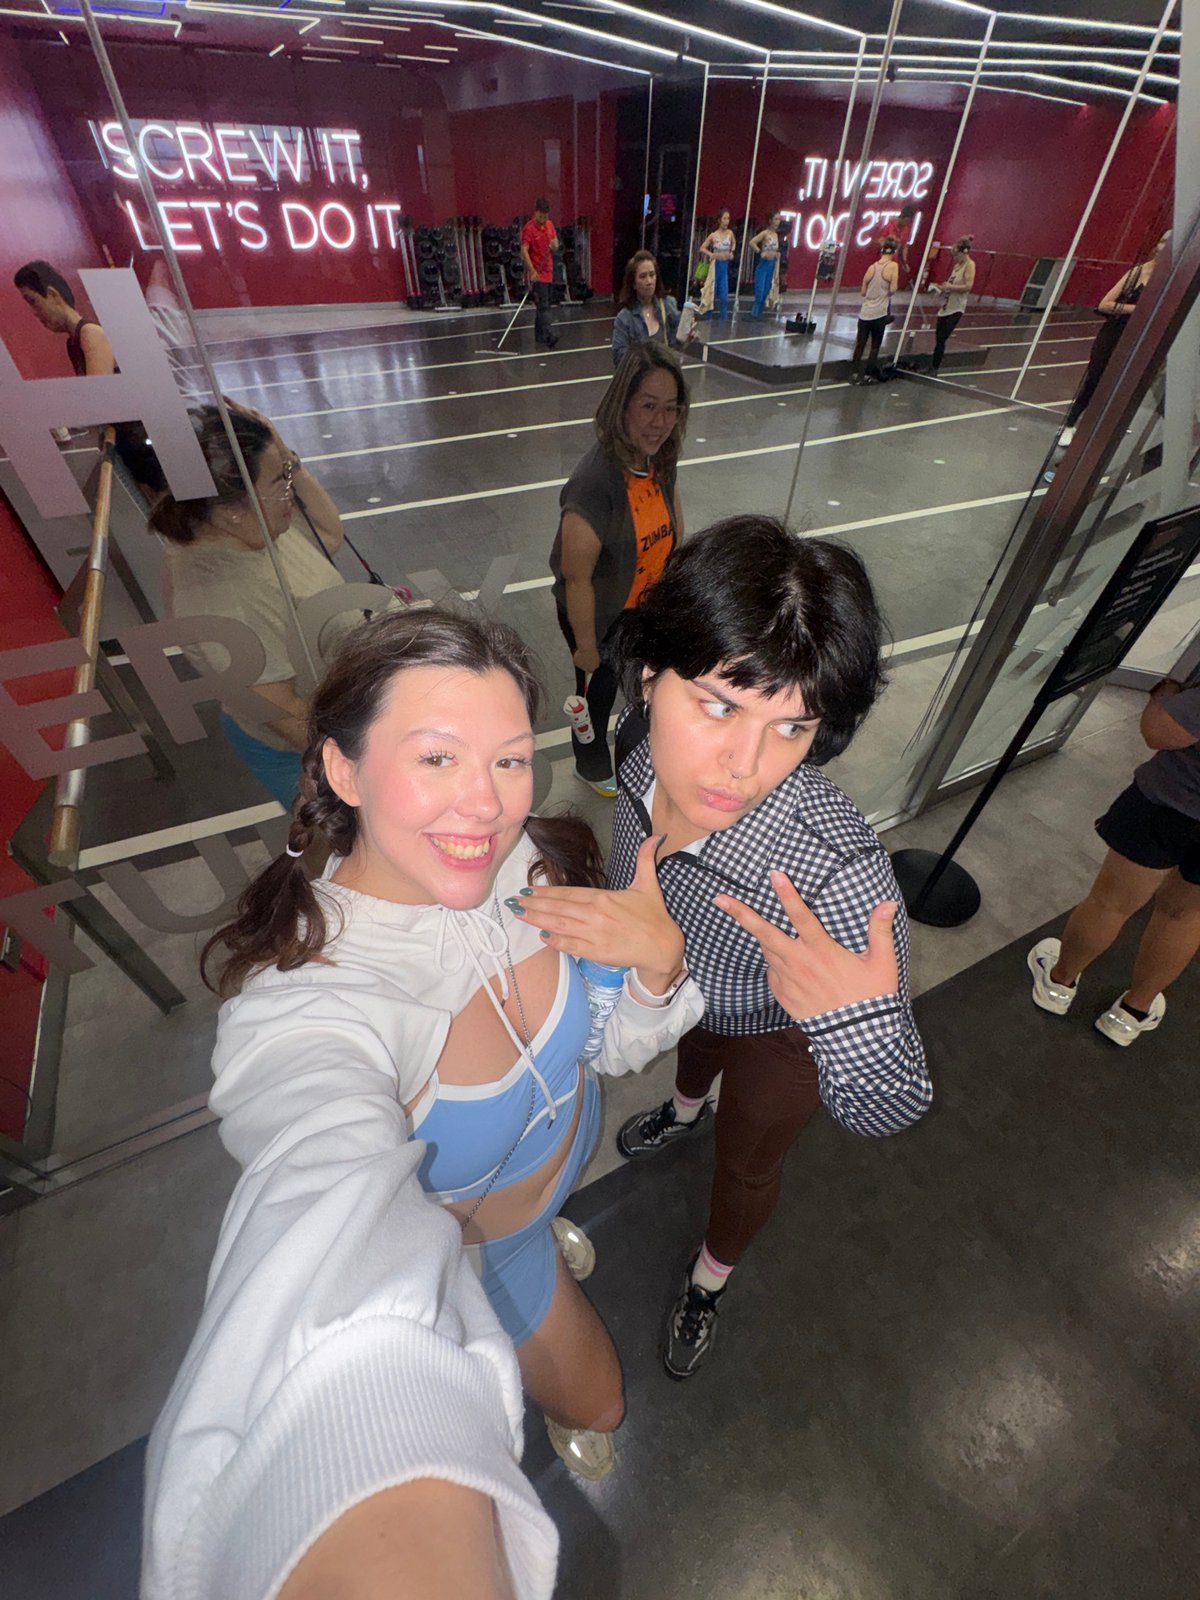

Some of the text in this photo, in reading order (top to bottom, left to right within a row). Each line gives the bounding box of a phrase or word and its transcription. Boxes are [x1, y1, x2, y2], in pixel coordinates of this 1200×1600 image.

[102, 121, 369, 192] SCREW IT,
[126, 201, 401, 250] LET'S DO IT
